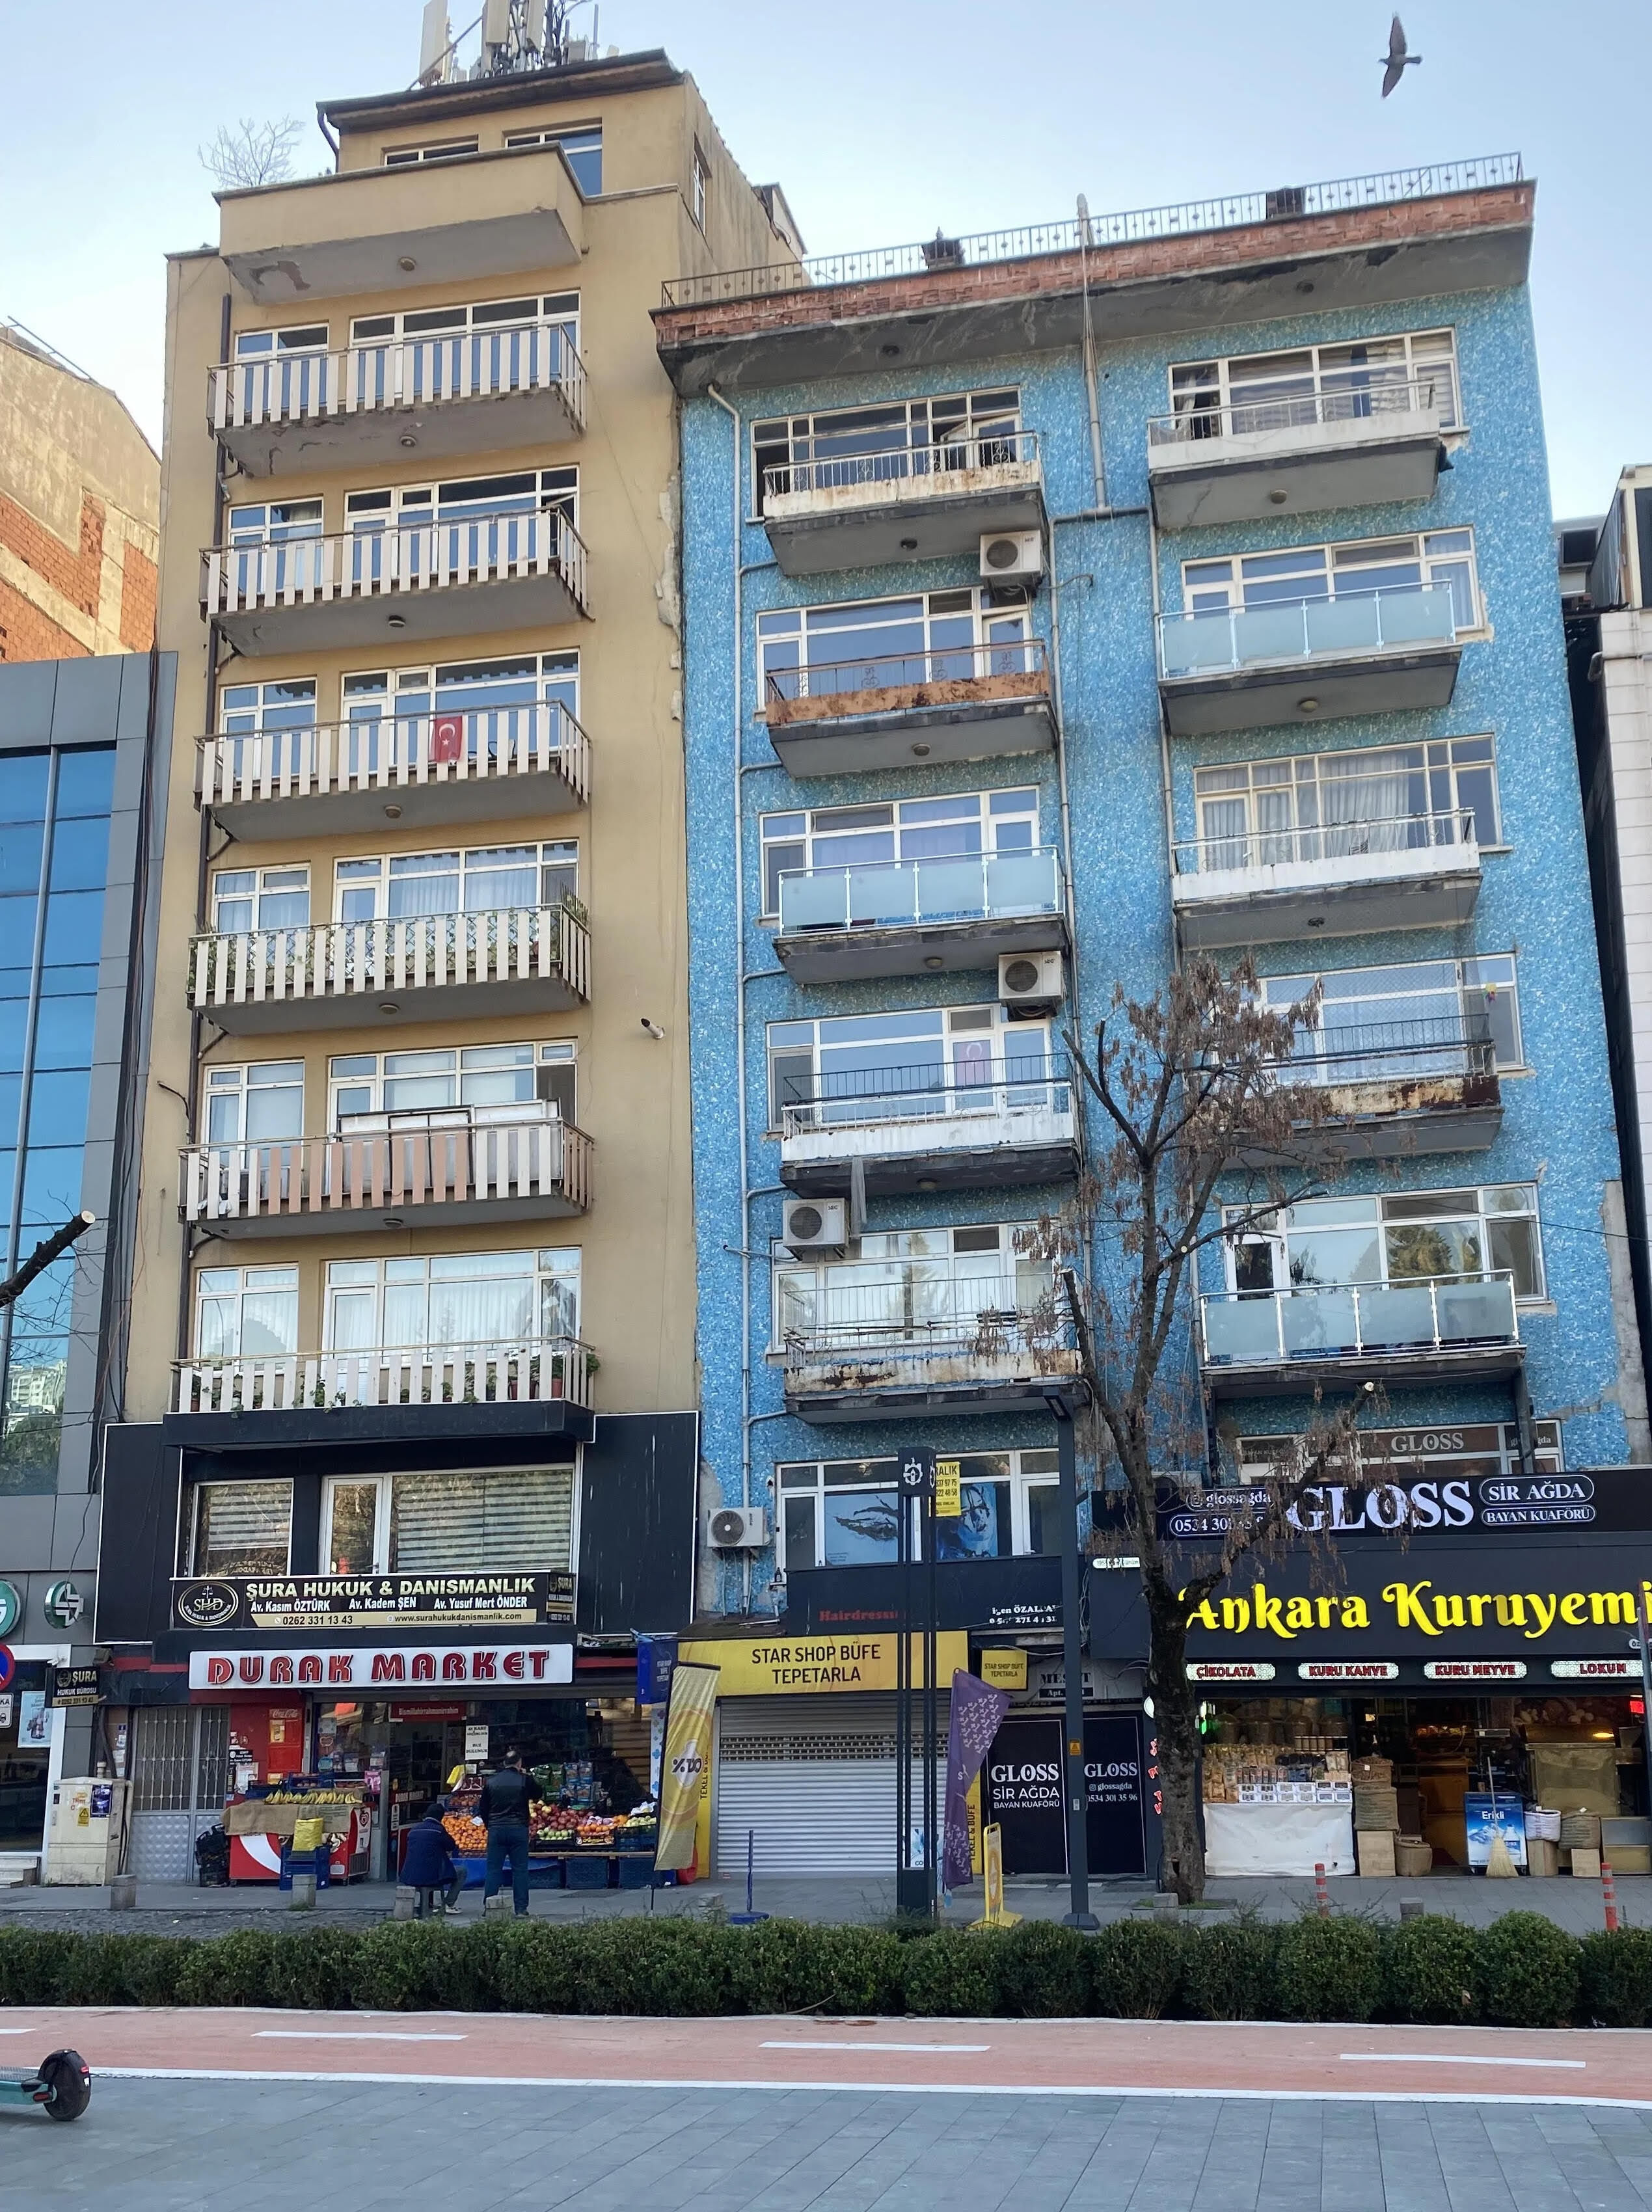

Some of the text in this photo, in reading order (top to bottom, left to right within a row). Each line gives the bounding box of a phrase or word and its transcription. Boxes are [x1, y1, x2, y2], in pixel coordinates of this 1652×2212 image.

[1391, 1433, 1464, 1452] GLOSS
[1489, 1480, 1586, 1501] SİR AĞDA
[1286, 1481, 1474, 1531] GLOSS
[1487, 1507, 1590, 1522] BAYAN KUAFÖRÜ
[247, 1578, 535, 1602] ŞURA HUKUK & DANISMANLIK
[251, 1595, 527, 1613] Av. Kasım ÖZTÜRK Av. Kadem ŞEN Av. Yusuf Mert ÖNDER
[1178, 1583, 1371, 1638] Ankara
[283, 1609, 522, 1625] 0262 331 13 43 www.surahukukdanismanlik.com
[752, 1641, 881, 1664] STAR SHOP BÜFE
[207, 1650, 550, 1685] DURAK MARKET
[772, 1666, 861, 1684] TEPETARLA
[1196, 1664, 1256, 1679] ÇİKOLATA
[1309, 1666, 1388, 1677] KURU KAHVE
[1435, 1664, 1516, 1676] KURU MEYVE
[1579, 1663, 1627, 1674] LOKUM
[72, 1670, 97, 1686] ŞURA
[991, 1763, 1059, 1783] GLOSS
[1084, 1762, 1138, 1777] GLOSS
[993, 1785, 1060, 1800] SİR AĞDA
